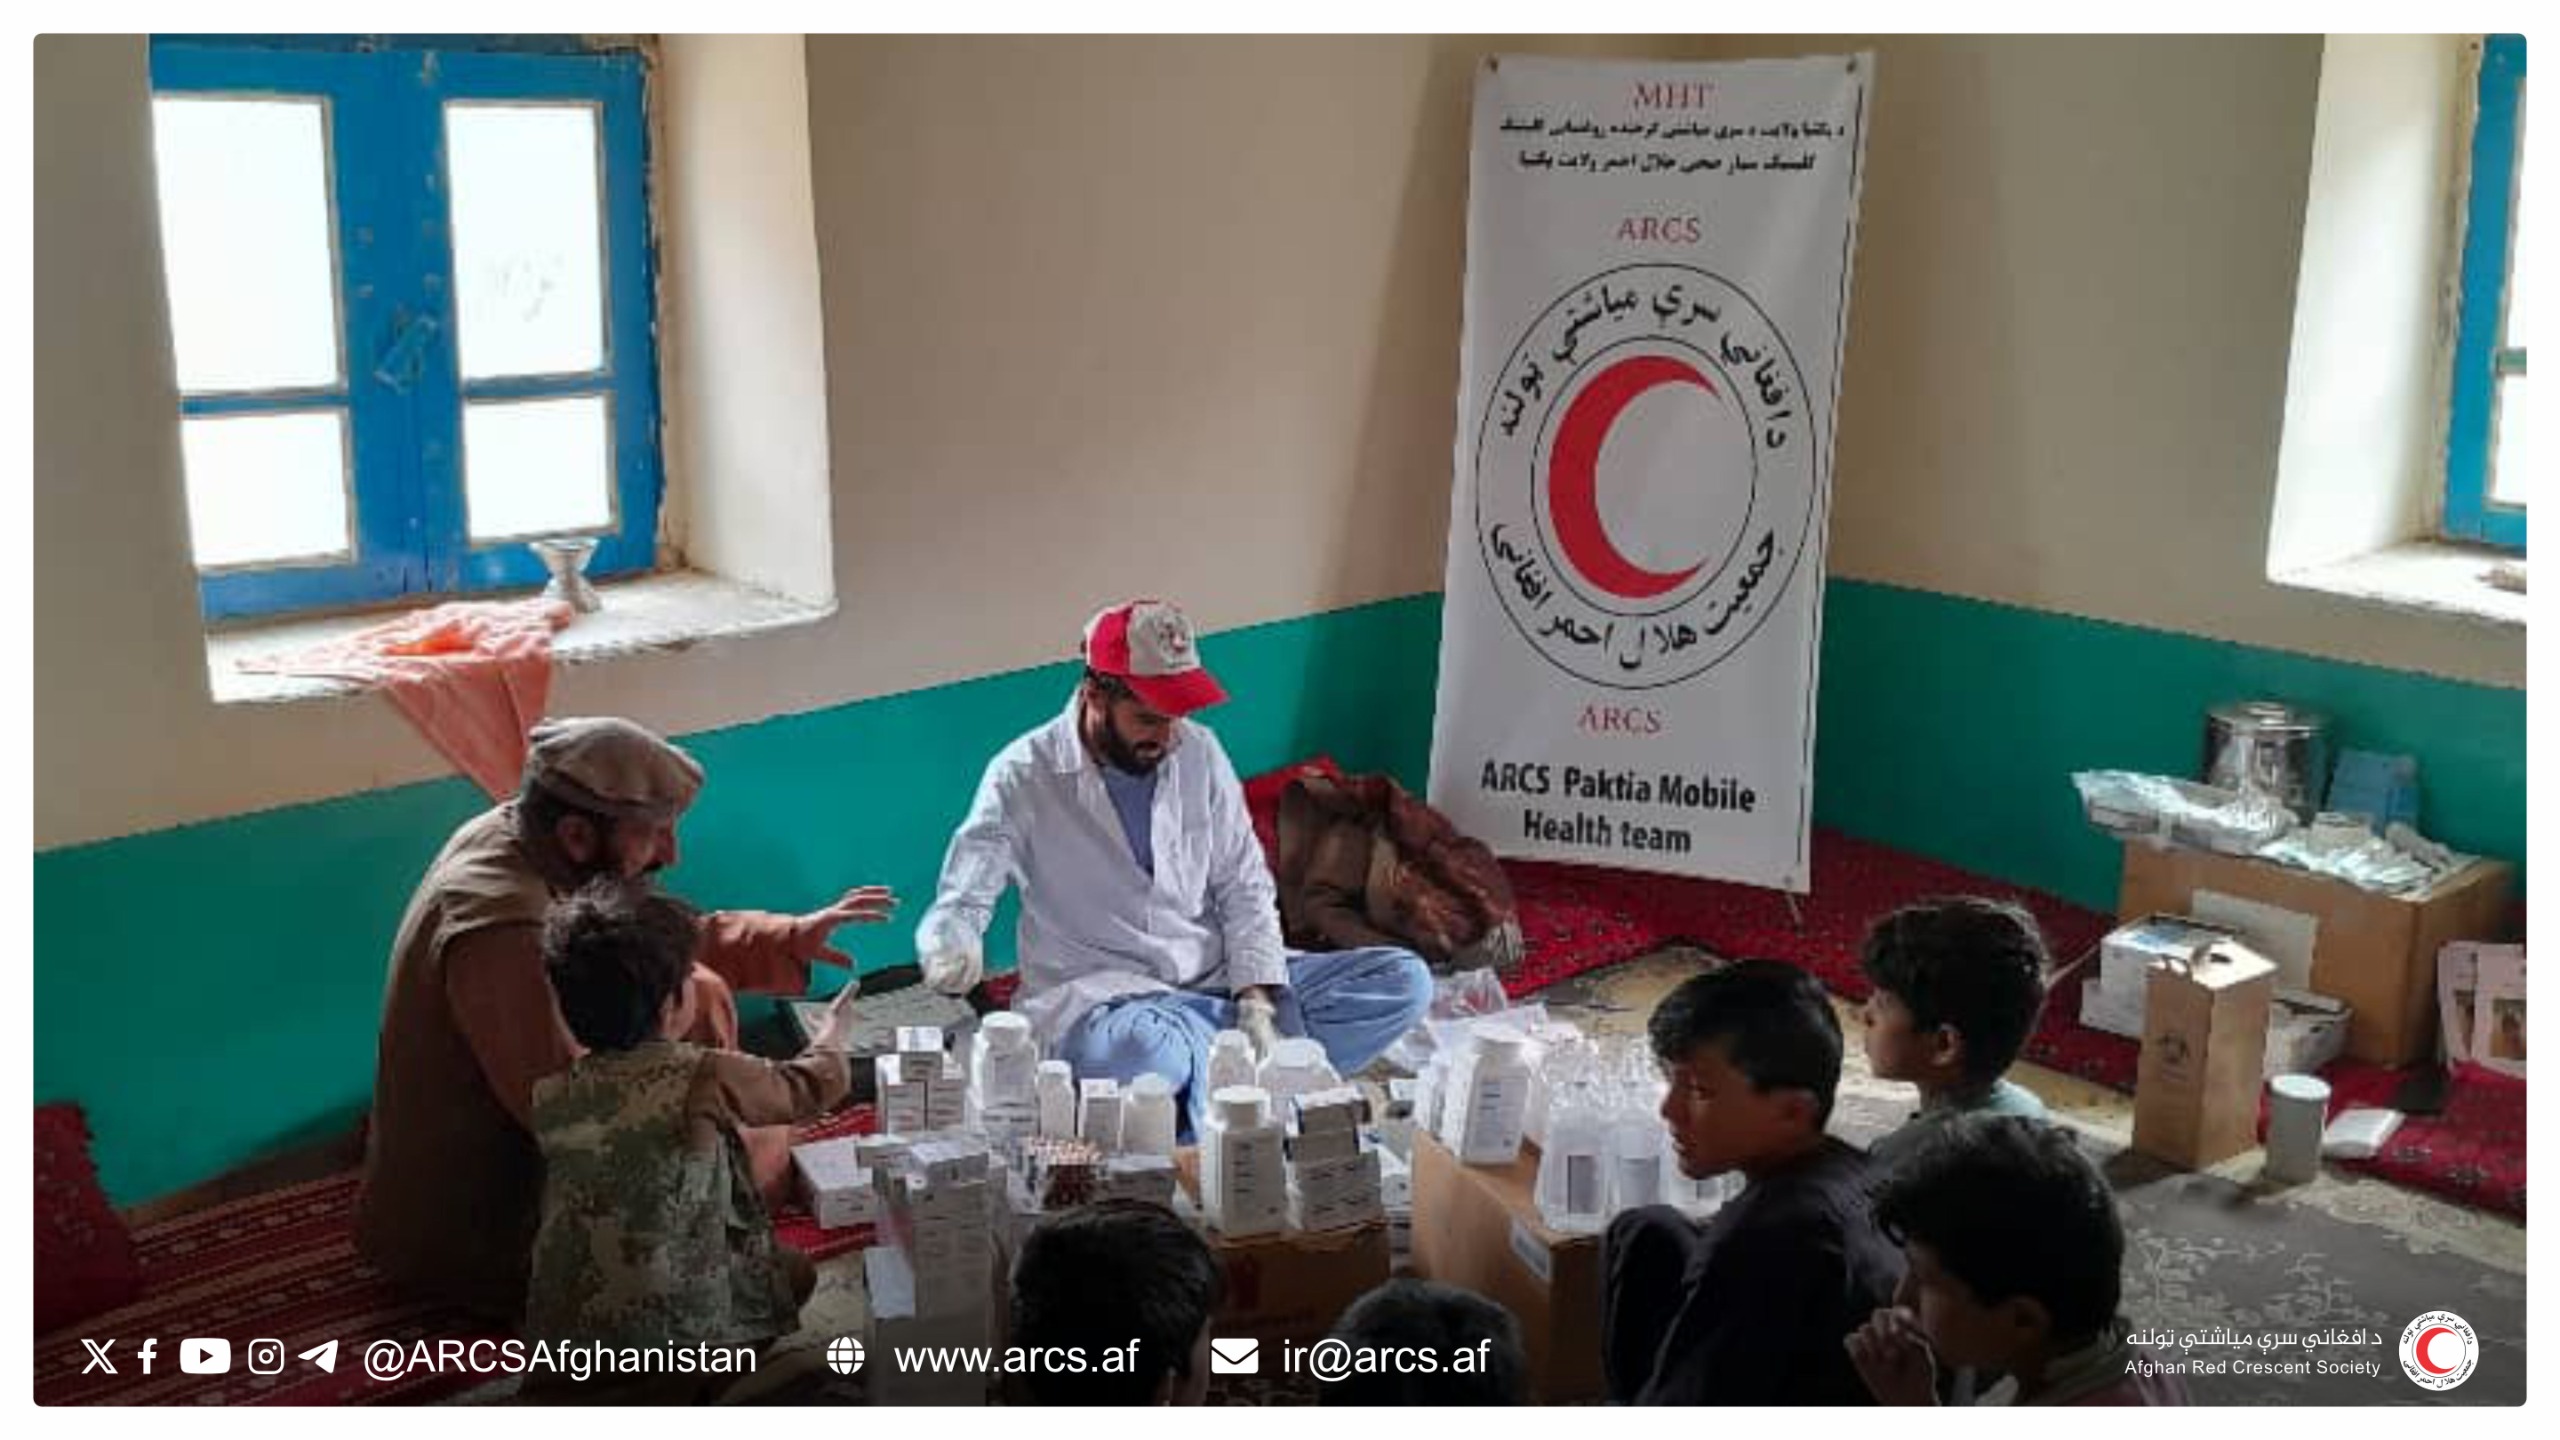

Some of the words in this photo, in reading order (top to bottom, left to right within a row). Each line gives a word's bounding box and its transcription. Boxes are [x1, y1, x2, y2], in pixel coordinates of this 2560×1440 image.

[1632, 82, 1715, 109] MHT
[1616, 217, 1701, 244] ARCS
[1578, 705, 1662, 734] ARCS
[1481, 760, 1550, 795] ARCS
[1564, 767, 1651, 804] Paktia
[1659, 775, 1757, 813] Mobile
[1524, 809, 1612, 848] Health
[1621, 820, 1692, 853] team
